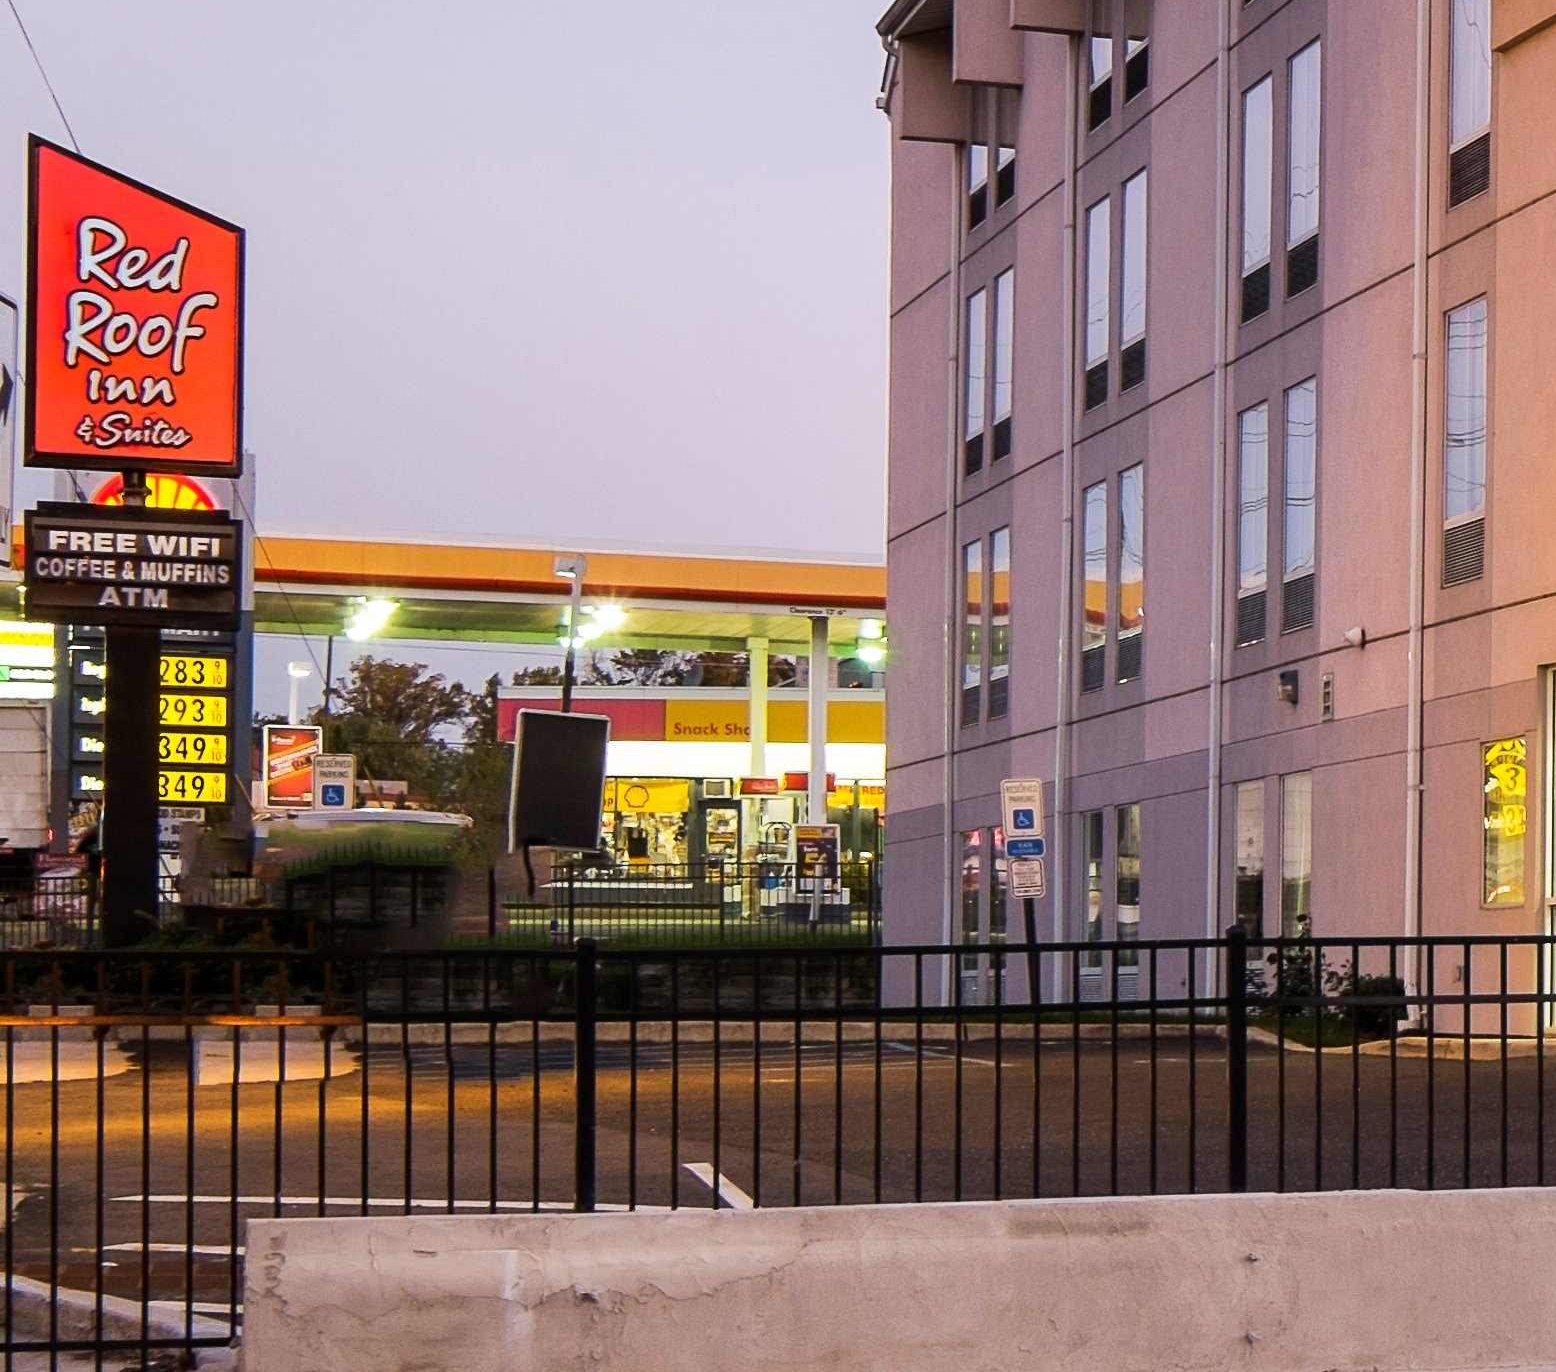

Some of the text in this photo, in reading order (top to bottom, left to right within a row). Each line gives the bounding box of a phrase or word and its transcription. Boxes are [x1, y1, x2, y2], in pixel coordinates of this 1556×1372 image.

[78, 216, 190, 292] Red
[64, 290, 218, 375] Roof
[88, 368, 176, 406] Inn
[94, 411, 193, 449] Suites
[49, 530, 220, 557] FREE WIFI
[35, 557, 116, 579] COFFEE
[122, 560, 135, 580] &
[98, 586, 168, 608] ATM
[160, 660, 204, 684] 283
[160, 698, 204, 722] 293
[674, 722, 719, 735] Snack
[159, 735, 206, 760] 349
[159, 774, 204, 798] 349
